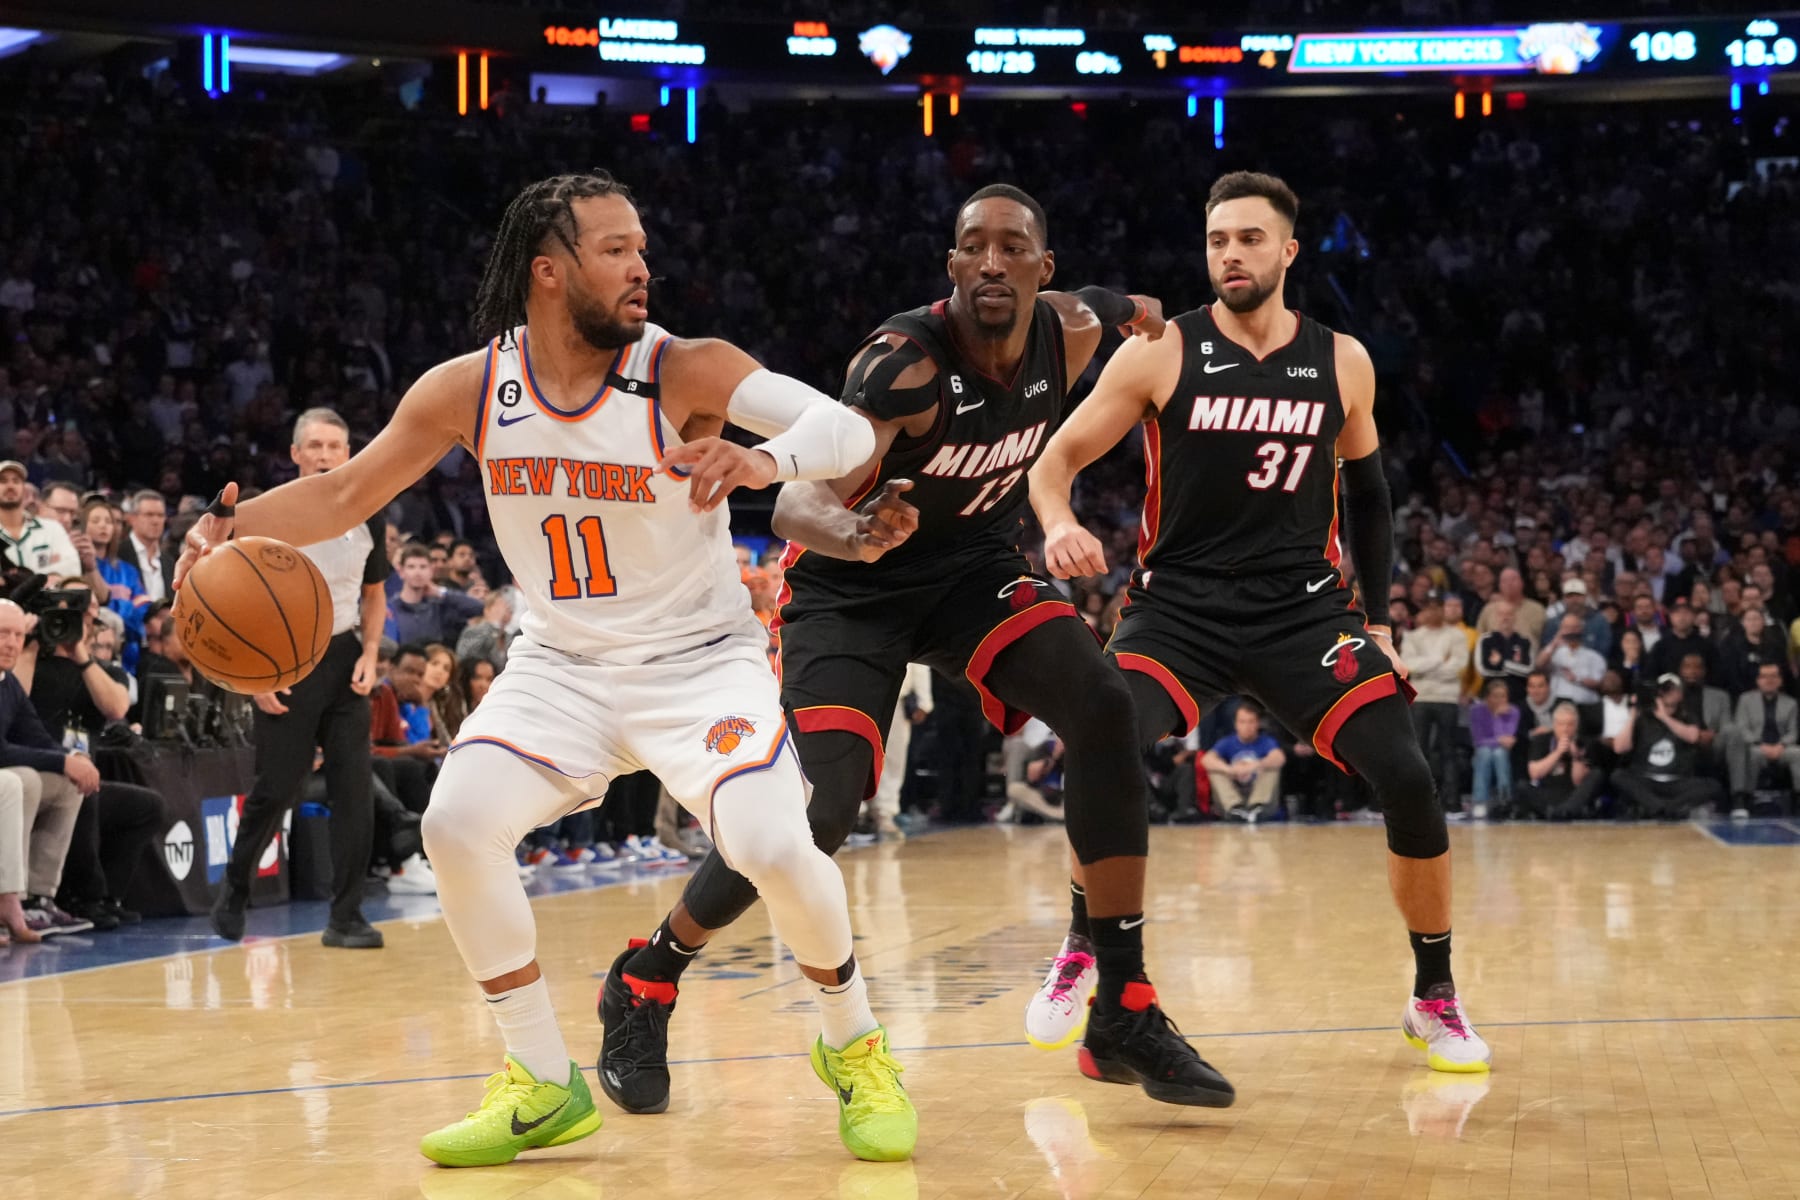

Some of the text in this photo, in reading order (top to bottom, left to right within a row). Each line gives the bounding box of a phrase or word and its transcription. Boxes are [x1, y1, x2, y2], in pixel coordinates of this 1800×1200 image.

[600, 18, 677, 41] LAKERS
[1179, 46, 1243, 63] BONUS
[1304, 41, 1356, 64] NEW
[1357, 41, 1419, 63] YORK
[1420, 40, 1504, 62] KNICKS
[1630, 31, 1697, 62] 108
[1725, 37, 1798, 67] 18.9
[1200, 341, 1213, 355] 6
[950, 375, 963, 393] 6
[1286, 366, 1318, 378] UKG
[503, 383, 517, 405] 6
[627, 381, 638, 391] 19
[1024, 379, 1048, 398] UKG
[1188, 396, 1326, 436] MIAMI
[921, 419, 1048, 478] MIAMI
[1246, 440, 1314, 493] 31
[487, 457, 656, 503] NEW YORK
[957, 466, 1025, 516] 13
[541, 514, 617, 600] 11
[164, 841, 194, 865] TNT
